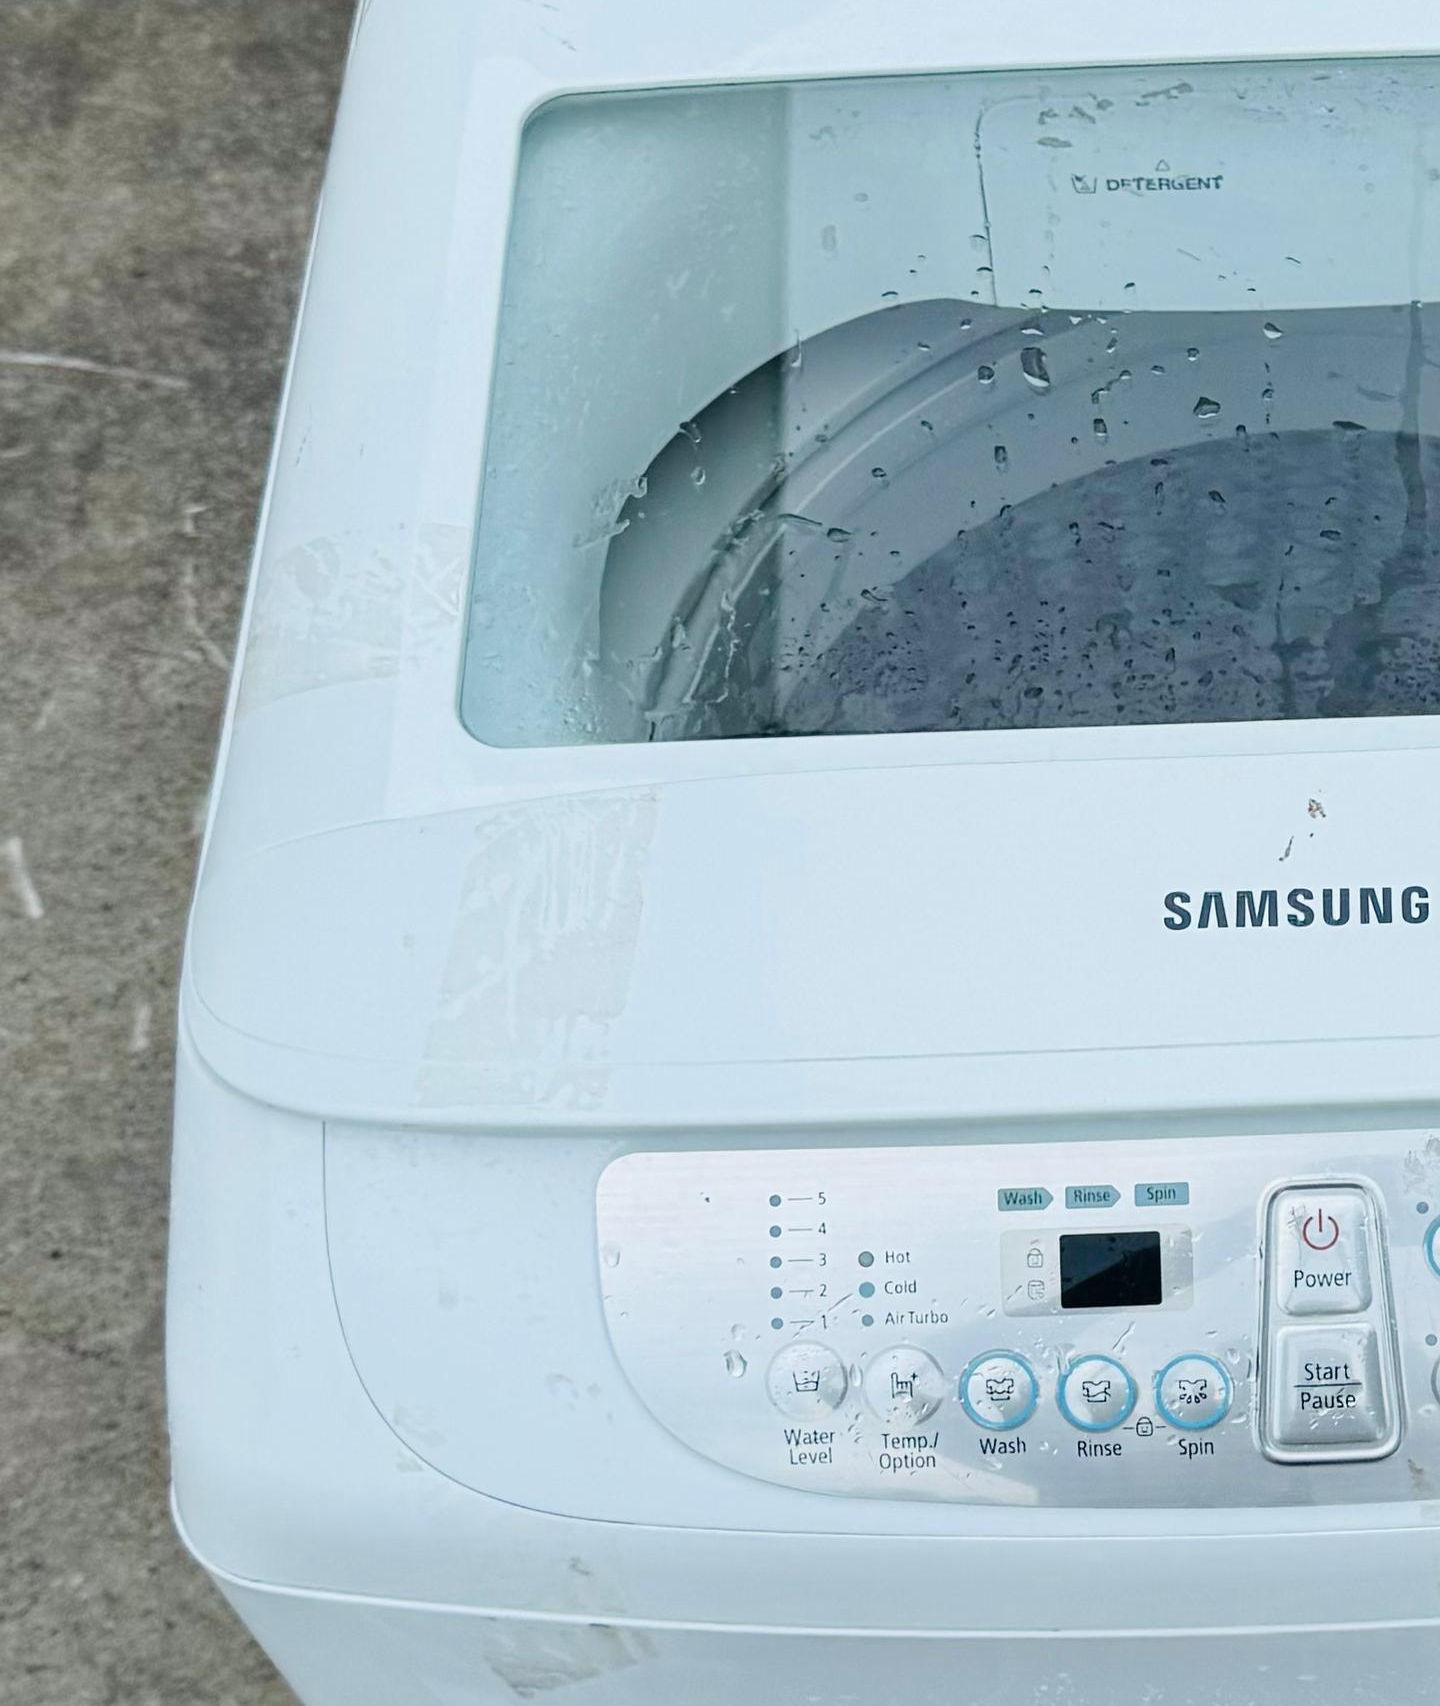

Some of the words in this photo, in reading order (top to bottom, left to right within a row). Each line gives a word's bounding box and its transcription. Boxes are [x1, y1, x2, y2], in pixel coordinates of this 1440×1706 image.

[1106, 175, 1224, 192] DETERGENT
[1163, 885, 1431, 931] SAMSUNG
[818, 1191, 827, 1205] 5
[1004, 1192, 1043, 1206] Wash
[1073, 1188, 1111, 1203] Rinse
[1146, 1186, 1177, 1202] Spin
[818, 1222, 827, 1235] 4
[819, 1253, 828, 1267] 3
[885, 1250, 912, 1264] Hot
[884, 1279, 918, 1295] Cold
[1294, 1269, 1352, 1288] Power
[819, 1284, 828, 1298] 2
[885, 1311, 905, 1326] Air
[907, 1310, 950, 1325] Turbo
[1304, 1362, 1351, 1381] Start
[1300, 1391, 1357, 1411] Pause
[784, 1428, 836, 1446] Water
[881, 1431, 940, 1453] Temp./
[979, 1437, 1027, 1455] Wash
[1077, 1440, 1123, 1458] Rinse
[1178, 1438, 1215, 1460] Spin
[789, 1448, 833, 1465] Level
[879, 1452, 936, 1472] Option
